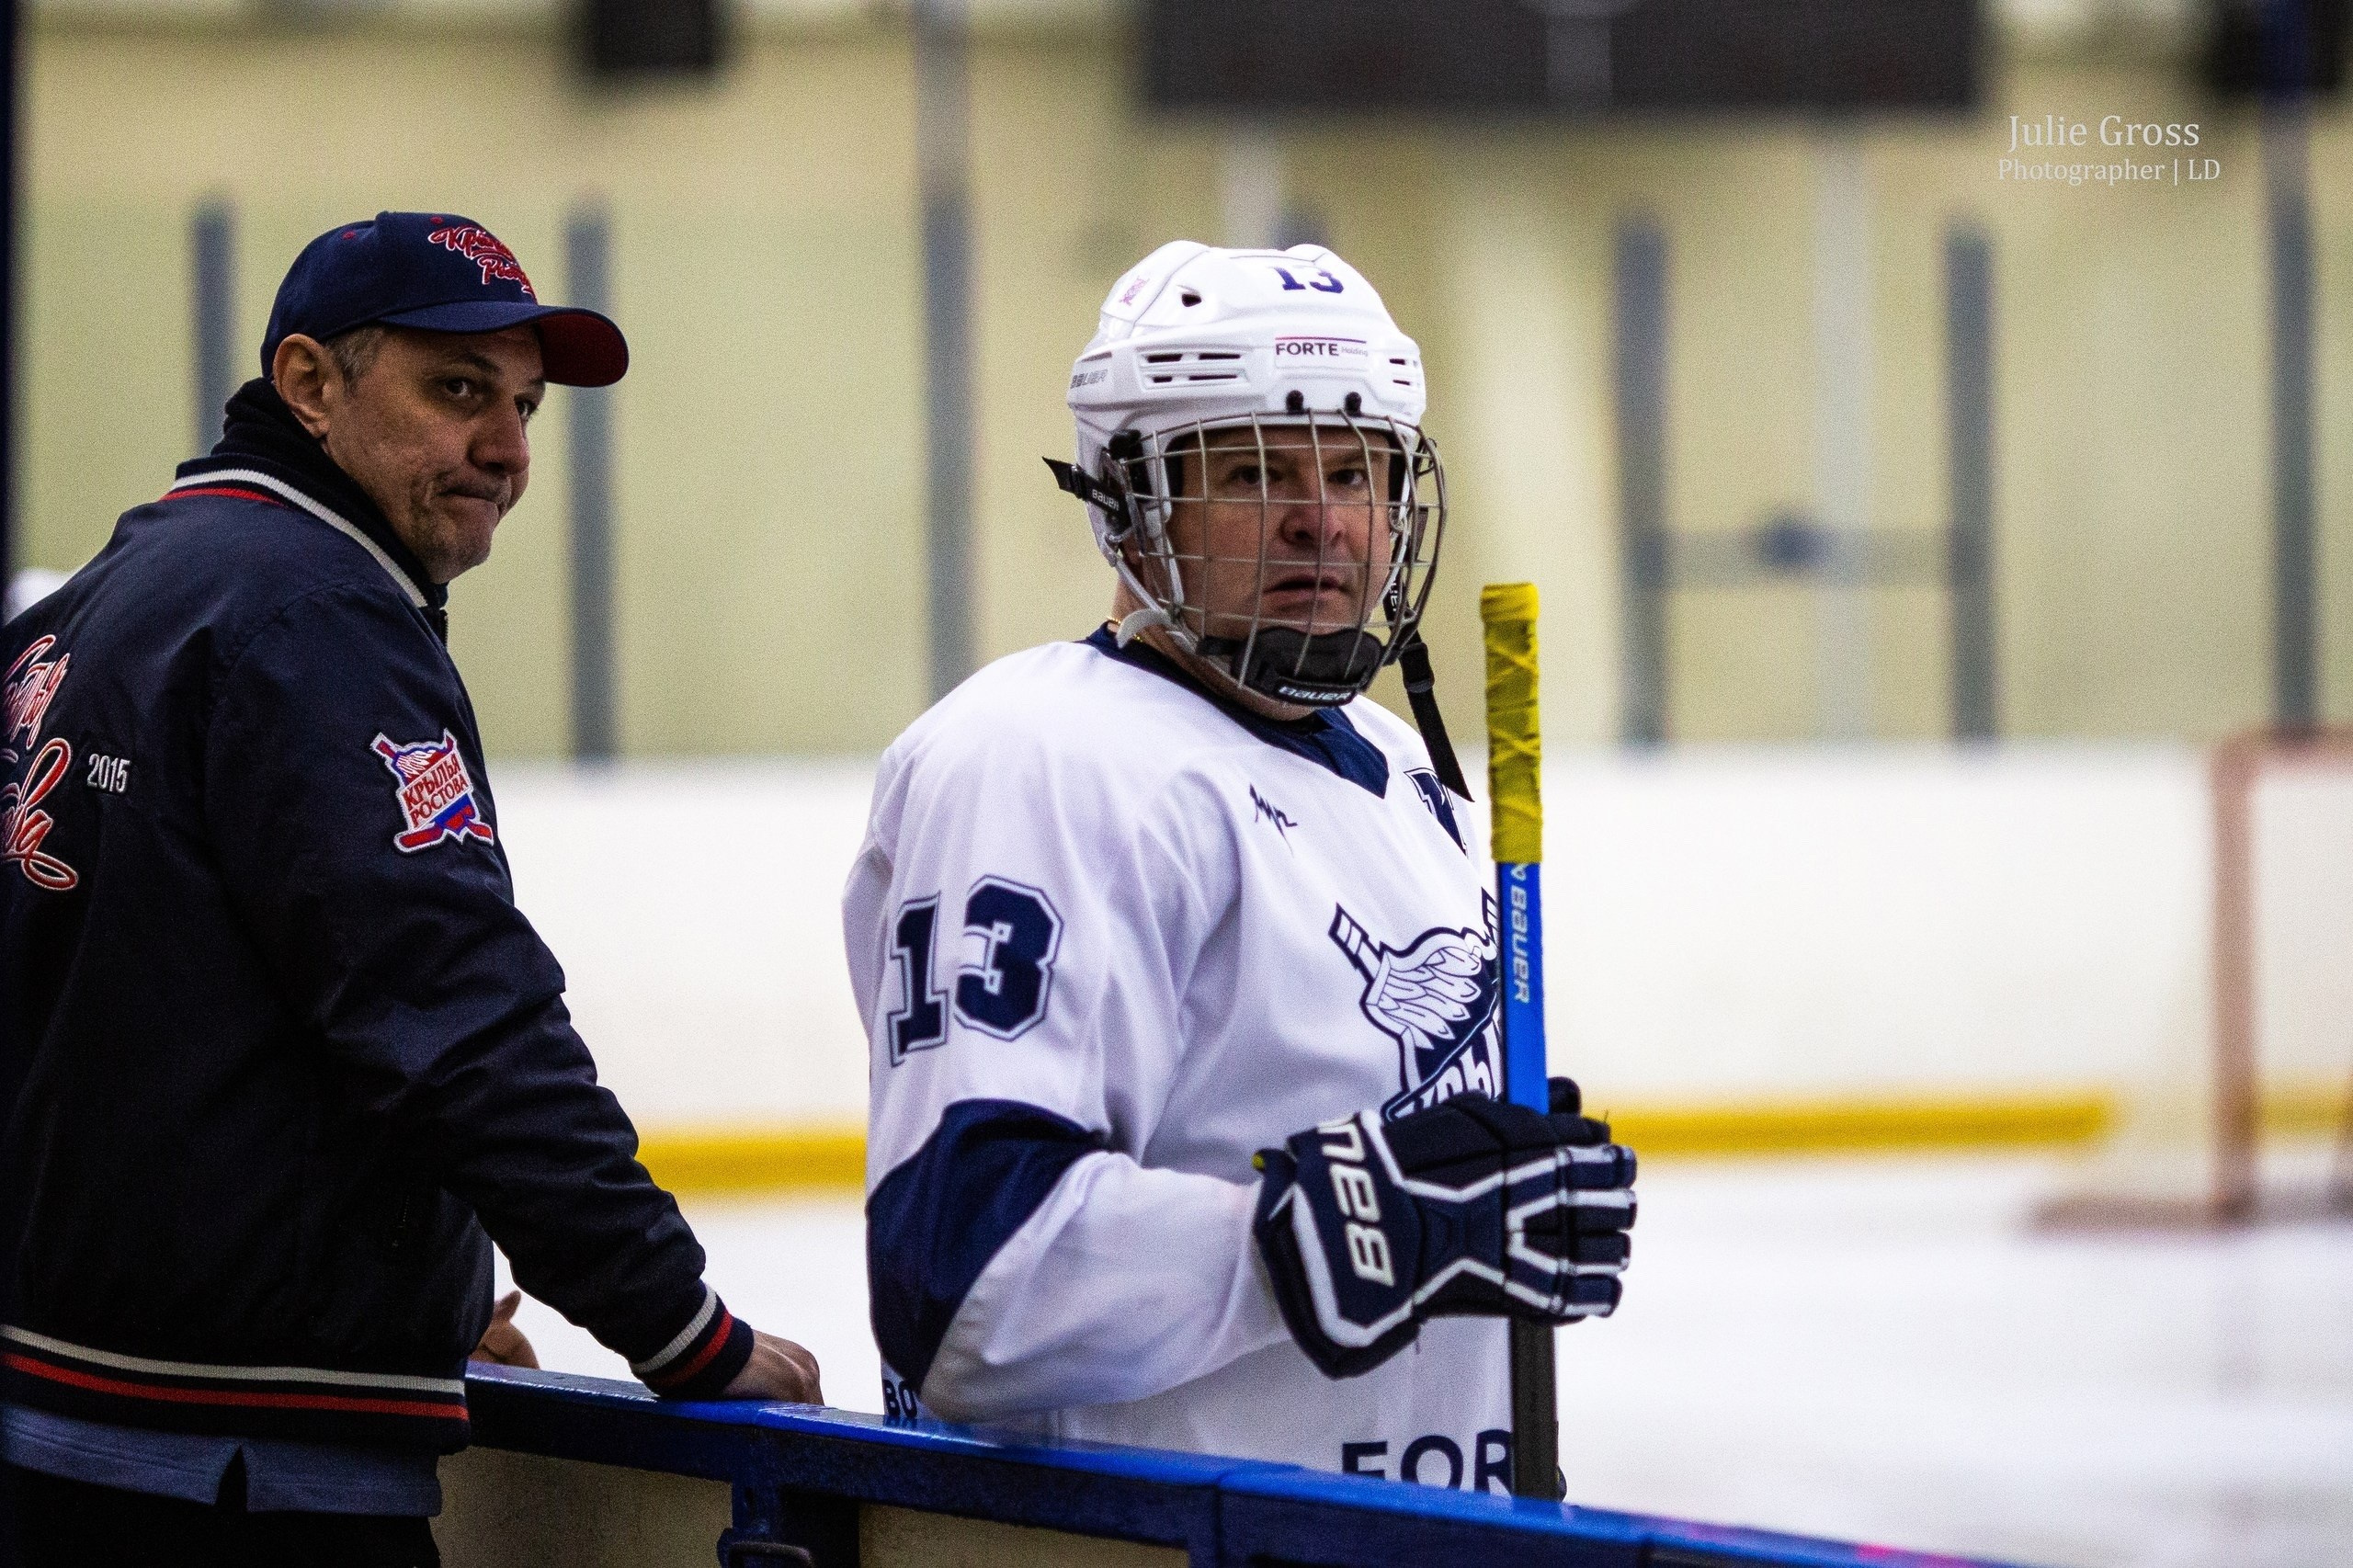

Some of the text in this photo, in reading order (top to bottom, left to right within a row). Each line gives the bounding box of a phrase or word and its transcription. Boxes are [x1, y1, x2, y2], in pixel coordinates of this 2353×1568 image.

[1272, 266, 1345, 294] 13
[1275, 342, 1369, 358] FORTE Holding
[86, 753, 131, 794] 2015
[402, 754, 461, 811] КРЫЛЬЯ
[409, 774, 470, 829] РОСТОВА
[887, 874, 1064, 1066] 13
[1510, 884, 1530, 1004] BAUER
